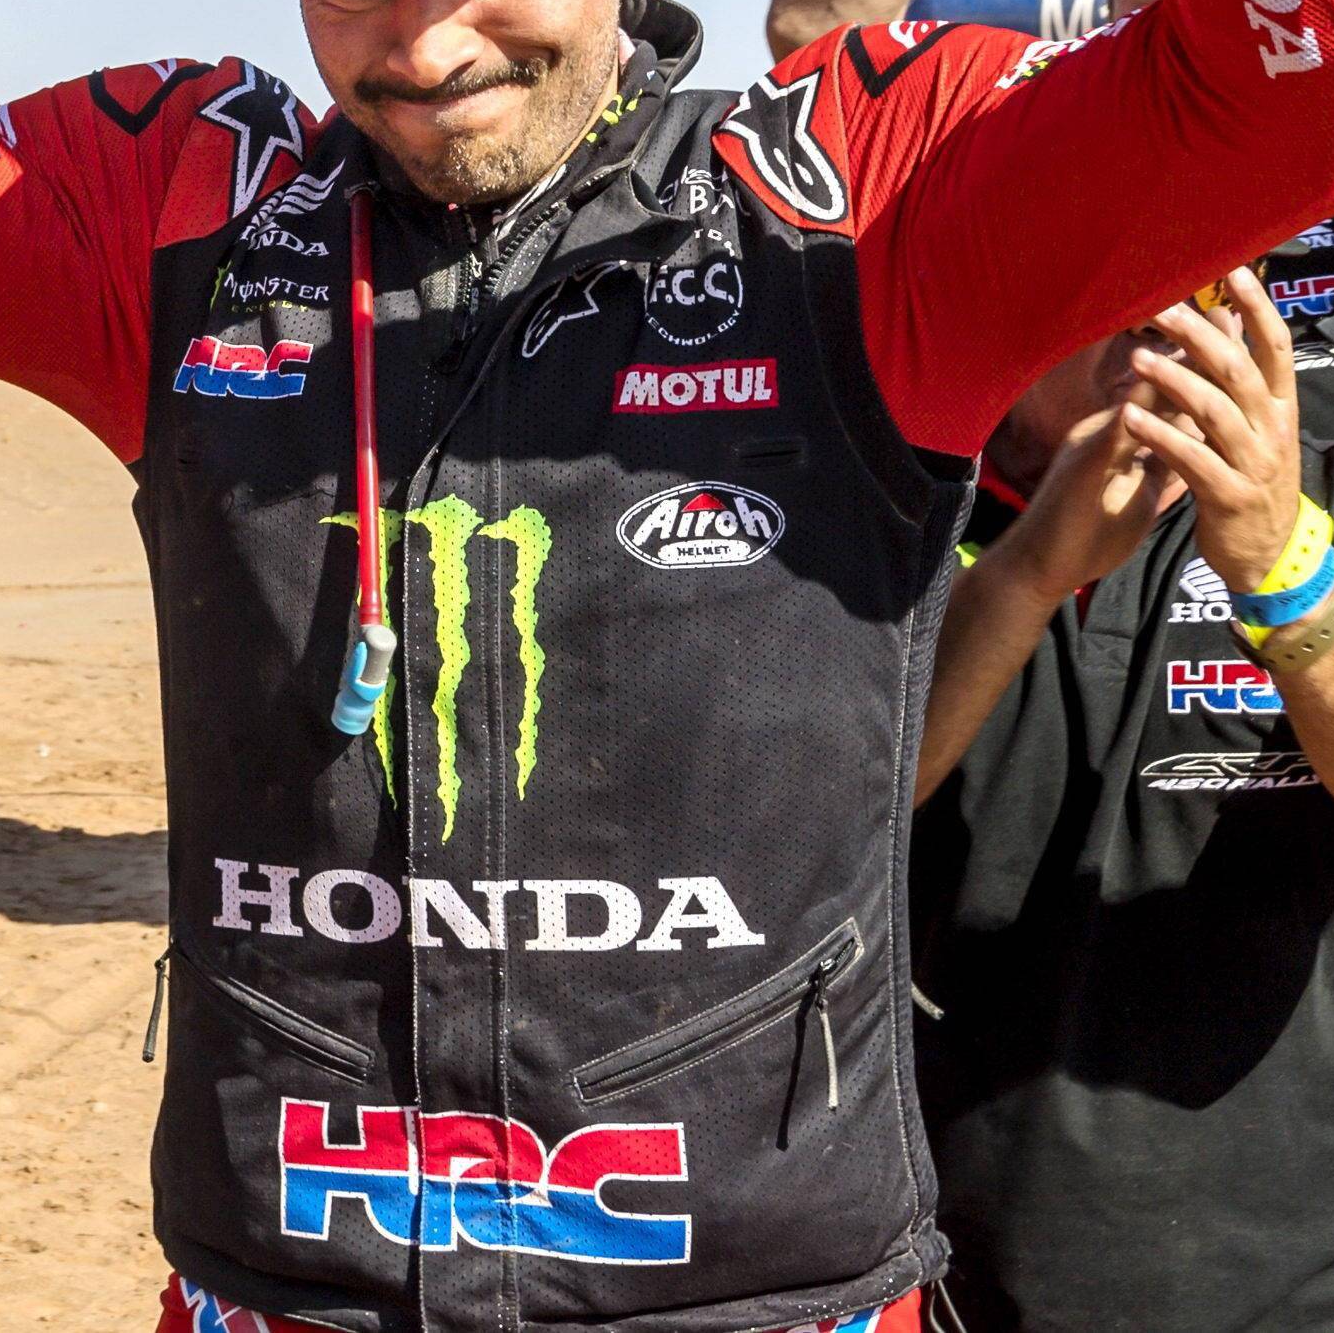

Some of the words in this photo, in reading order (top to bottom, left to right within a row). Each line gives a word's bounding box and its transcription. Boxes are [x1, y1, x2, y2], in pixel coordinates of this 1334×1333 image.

[619, 366, 772, 407] MOTUL
[632, 496, 773, 547] Airoh
[677, 545, 730, 557] HELMET
[211, 857, 766, 953] HONDA
[278, 1095, 693, 1265] HRC
